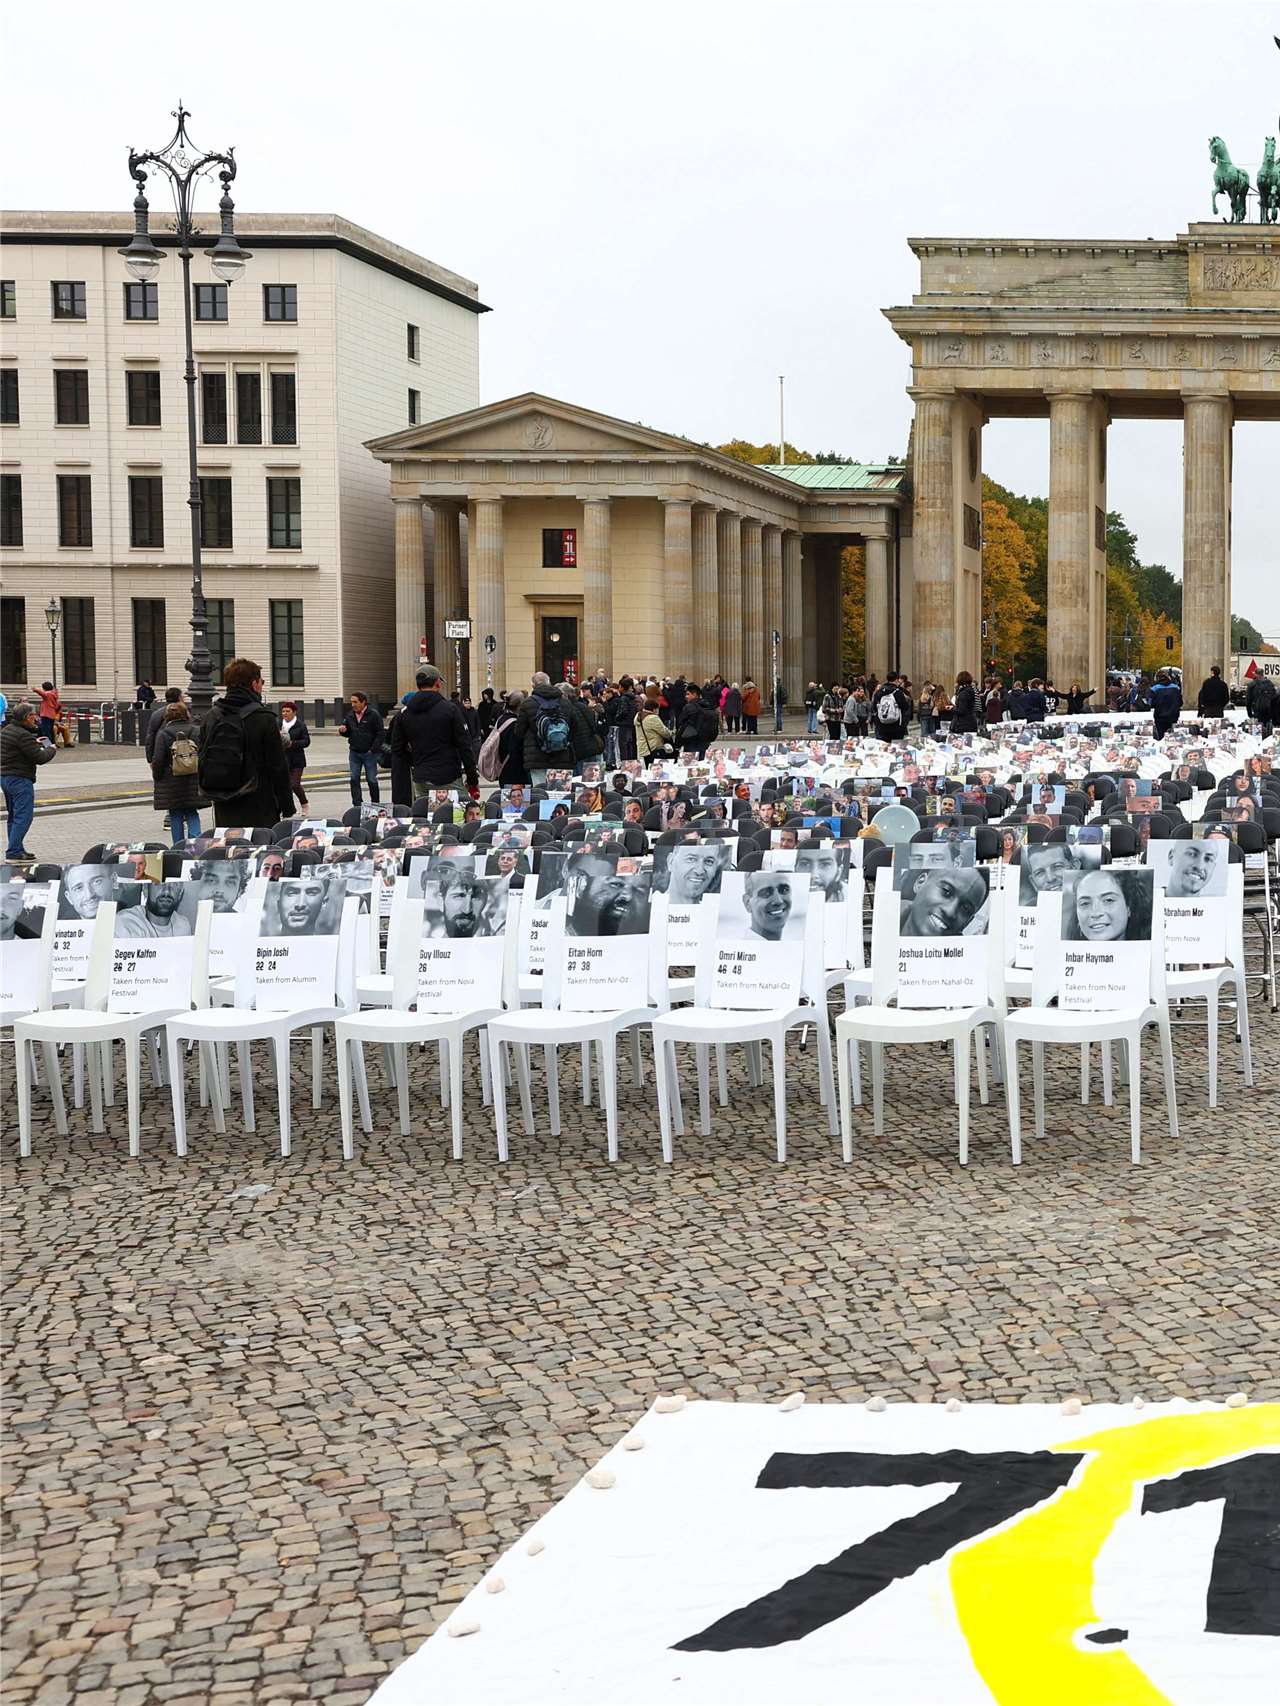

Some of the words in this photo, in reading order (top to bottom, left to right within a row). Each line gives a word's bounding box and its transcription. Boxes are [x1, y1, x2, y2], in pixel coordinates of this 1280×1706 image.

[1264, 664, 1280, 675] BVS
[1192, 908, 1204, 916] Mor
[532, 919, 548, 928] Hadar
[1020, 917, 1029, 925] Tal
[1030, 917, 1036, 925] H
[55, 930, 77, 938] vinatan
[78, 930, 84, 938] Or
[531, 931, 538, 940] 23
[1020, 929, 1027, 938] 41
[62, 941, 70, 950] 32
[115, 950, 135, 960] Segev
[137, 949, 156, 958] Kalfon
[257, 948, 272, 958] Bipin
[273, 947, 289, 957] Joshi
[420, 950, 431, 961] Guy
[433, 949, 451, 959] Illouz
[568, 948, 585, 957] Eitan
[586, 948, 603, 957] Horn
[719, 951, 735, 960] Omri
[737, 951, 756, 961] Miran
[899, 948, 923, 958] Joshua
[925, 948, 942, 958] Loitu
[944, 947, 963, 957] Mollel
[1066, 953, 1083, 962] Inbar
[1085, 953, 1114, 964] Hayman
[128, 962, 136, 972] 27
[268, 962, 276, 970] 24
[419, 963, 426, 972] 26
[581, 962, 590, 971] 38
[732, 965, 742, 975] 48
[899, 962, 906, 972] 21
[1065, 967, 1074, 976] 27
